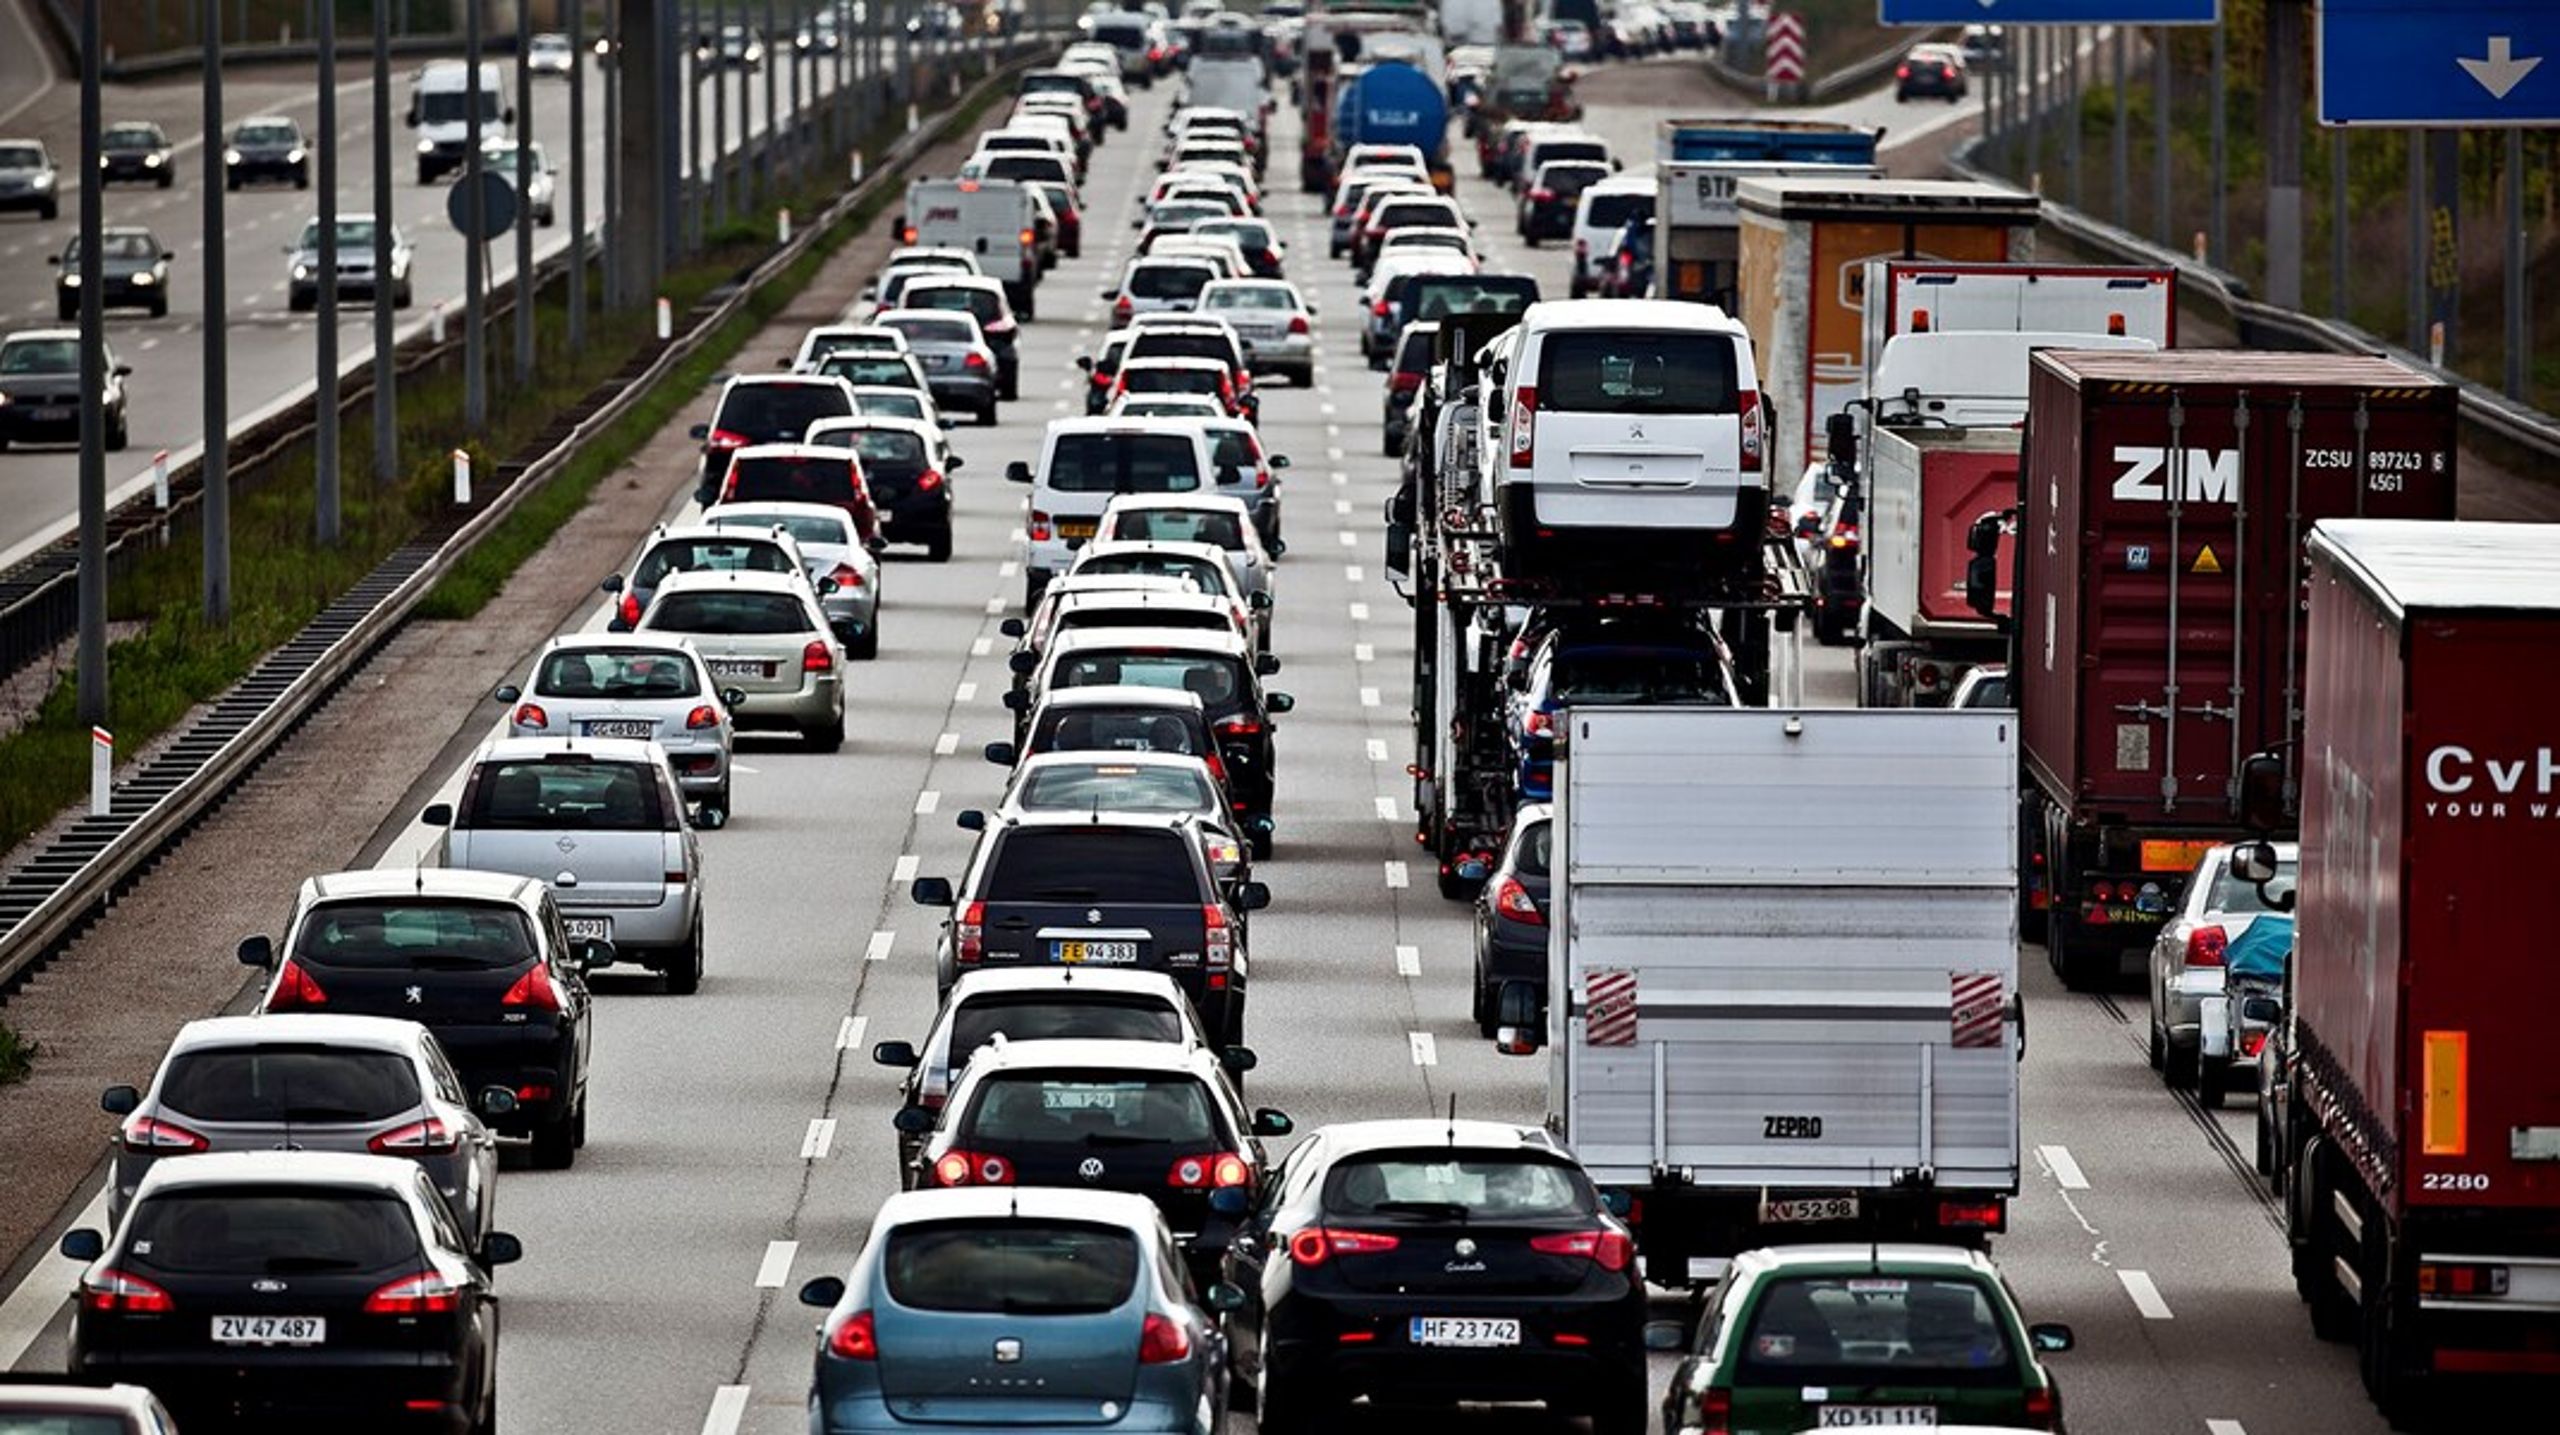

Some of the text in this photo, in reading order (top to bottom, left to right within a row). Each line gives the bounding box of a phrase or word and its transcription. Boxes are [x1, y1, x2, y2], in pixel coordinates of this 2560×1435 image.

[2305, 449, 2352, 468] ZCSU
[2369, 451, 2422, 470] 897243
[2113, 446, 2240, 503] ZIM
[2369, 473, 2403, 491] 45G1
[2426, 802, 2560, 818] YOUR W
[1062, 943, 1080, 958] FE
[1764, 1116, 1822, 1139] ZEPRO
[2423, 1173, 2489, 1189] 2280
[1767, 1200, 1852, 1220] KV 52 98
[222, 1319, 317, 1338] ZV 47 487
[1425, 1321, 1516, 1340] HF 23 742
[1824, 1408, 1855, 1427] XD
